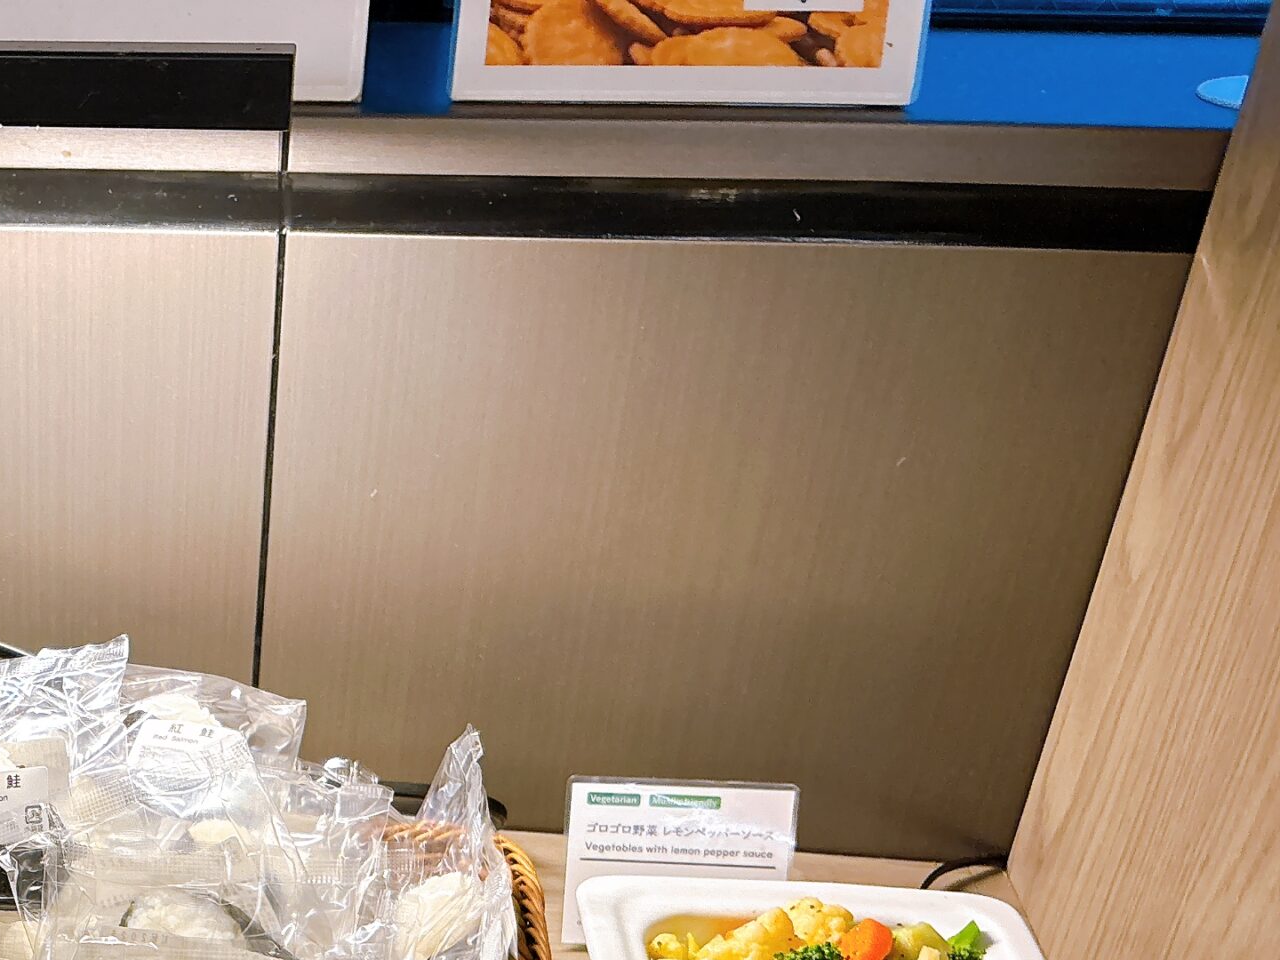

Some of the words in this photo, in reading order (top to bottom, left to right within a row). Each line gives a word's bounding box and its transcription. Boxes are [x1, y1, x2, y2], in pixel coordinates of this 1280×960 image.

[590, 794, 639, 806] Vegetarian
[586, 823, 658, 837] ゴロゴロ野菜
[663, 826, 775, 841] レモンペッパーソース
[585, 842, 643, 854] Vegetables
[646, 844, 668, 854] with
[671, 845, 701, 855] lemon
[703, 849, 740, 860] pepper
[743, 850, 773, 859] sauce
